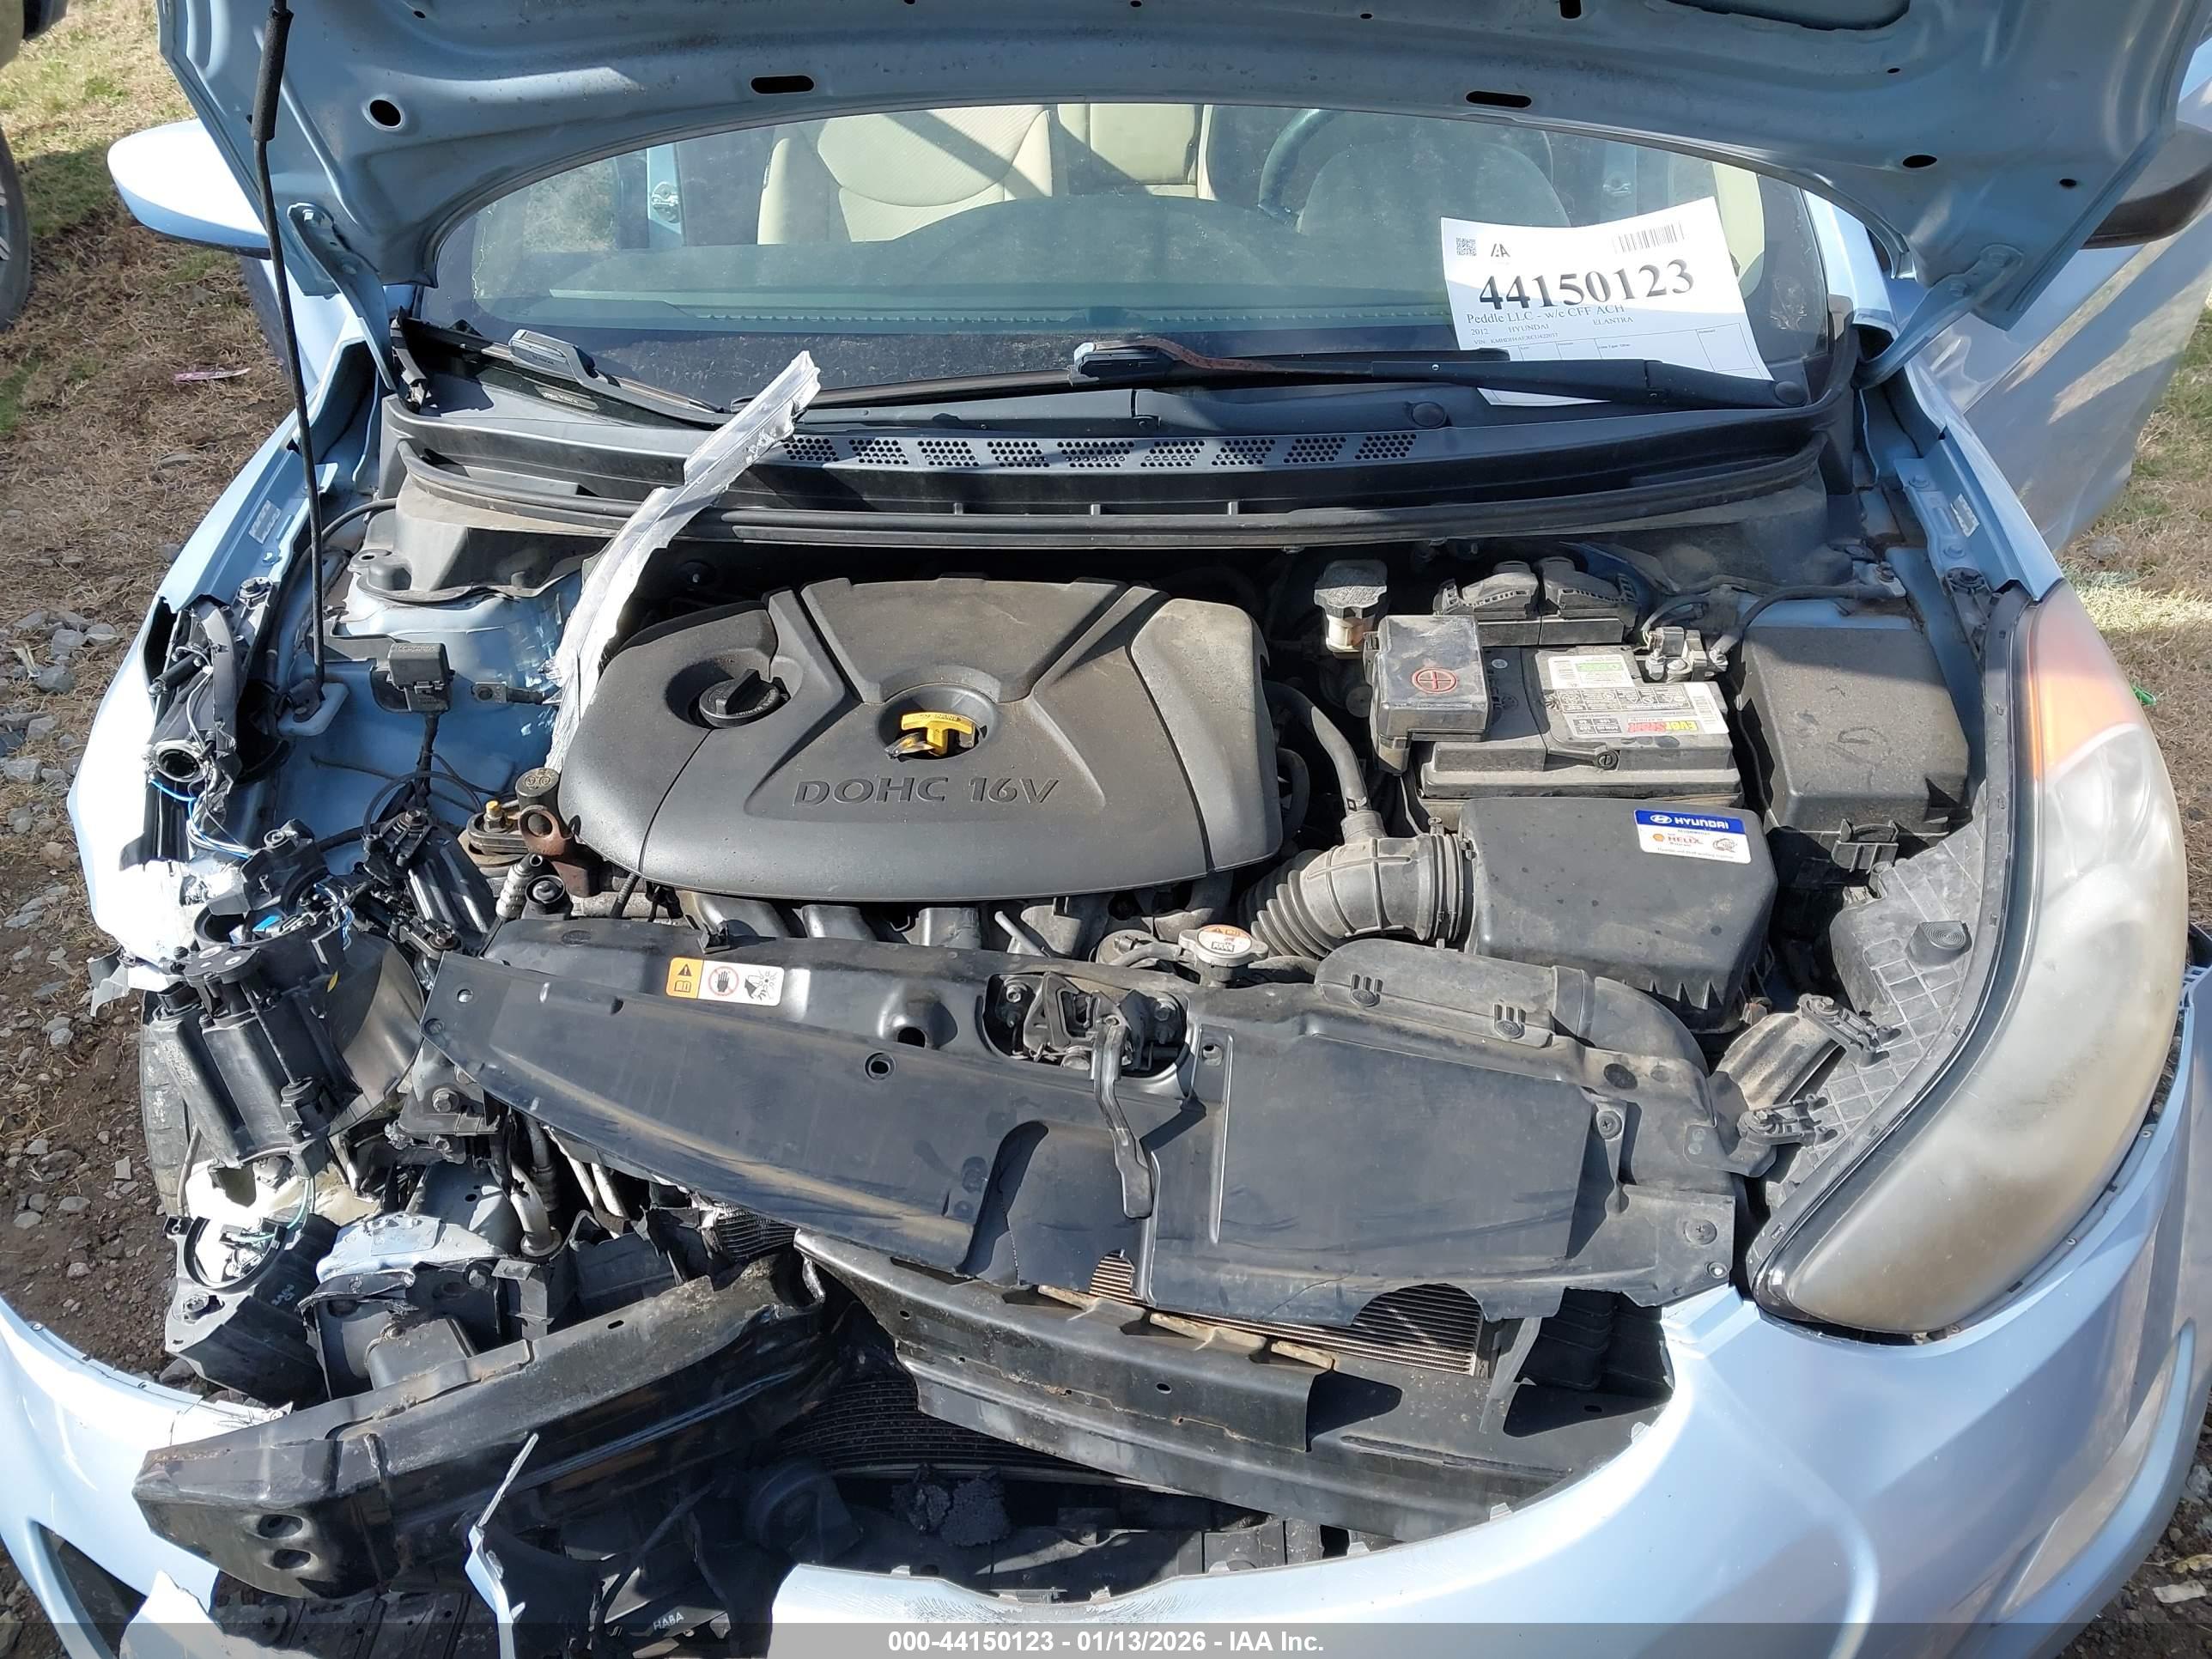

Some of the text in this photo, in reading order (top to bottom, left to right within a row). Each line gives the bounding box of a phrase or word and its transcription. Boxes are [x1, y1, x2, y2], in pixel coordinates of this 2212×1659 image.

[1479, 258, 1694, 310] 44150123
[1466, 313, 1504, 324] Peddle
[1507, 311, 1534, 322] LLC
[1596, 304, 1626, 315] ACH
[1508, 324, 1549, 333] HYUNDAI
[1593, 316, 1634, 325] ELANTRA
[793, 776, 1060, 805] DOHC 16V
[1674, 817, 1729, 830] HYUNDAI
